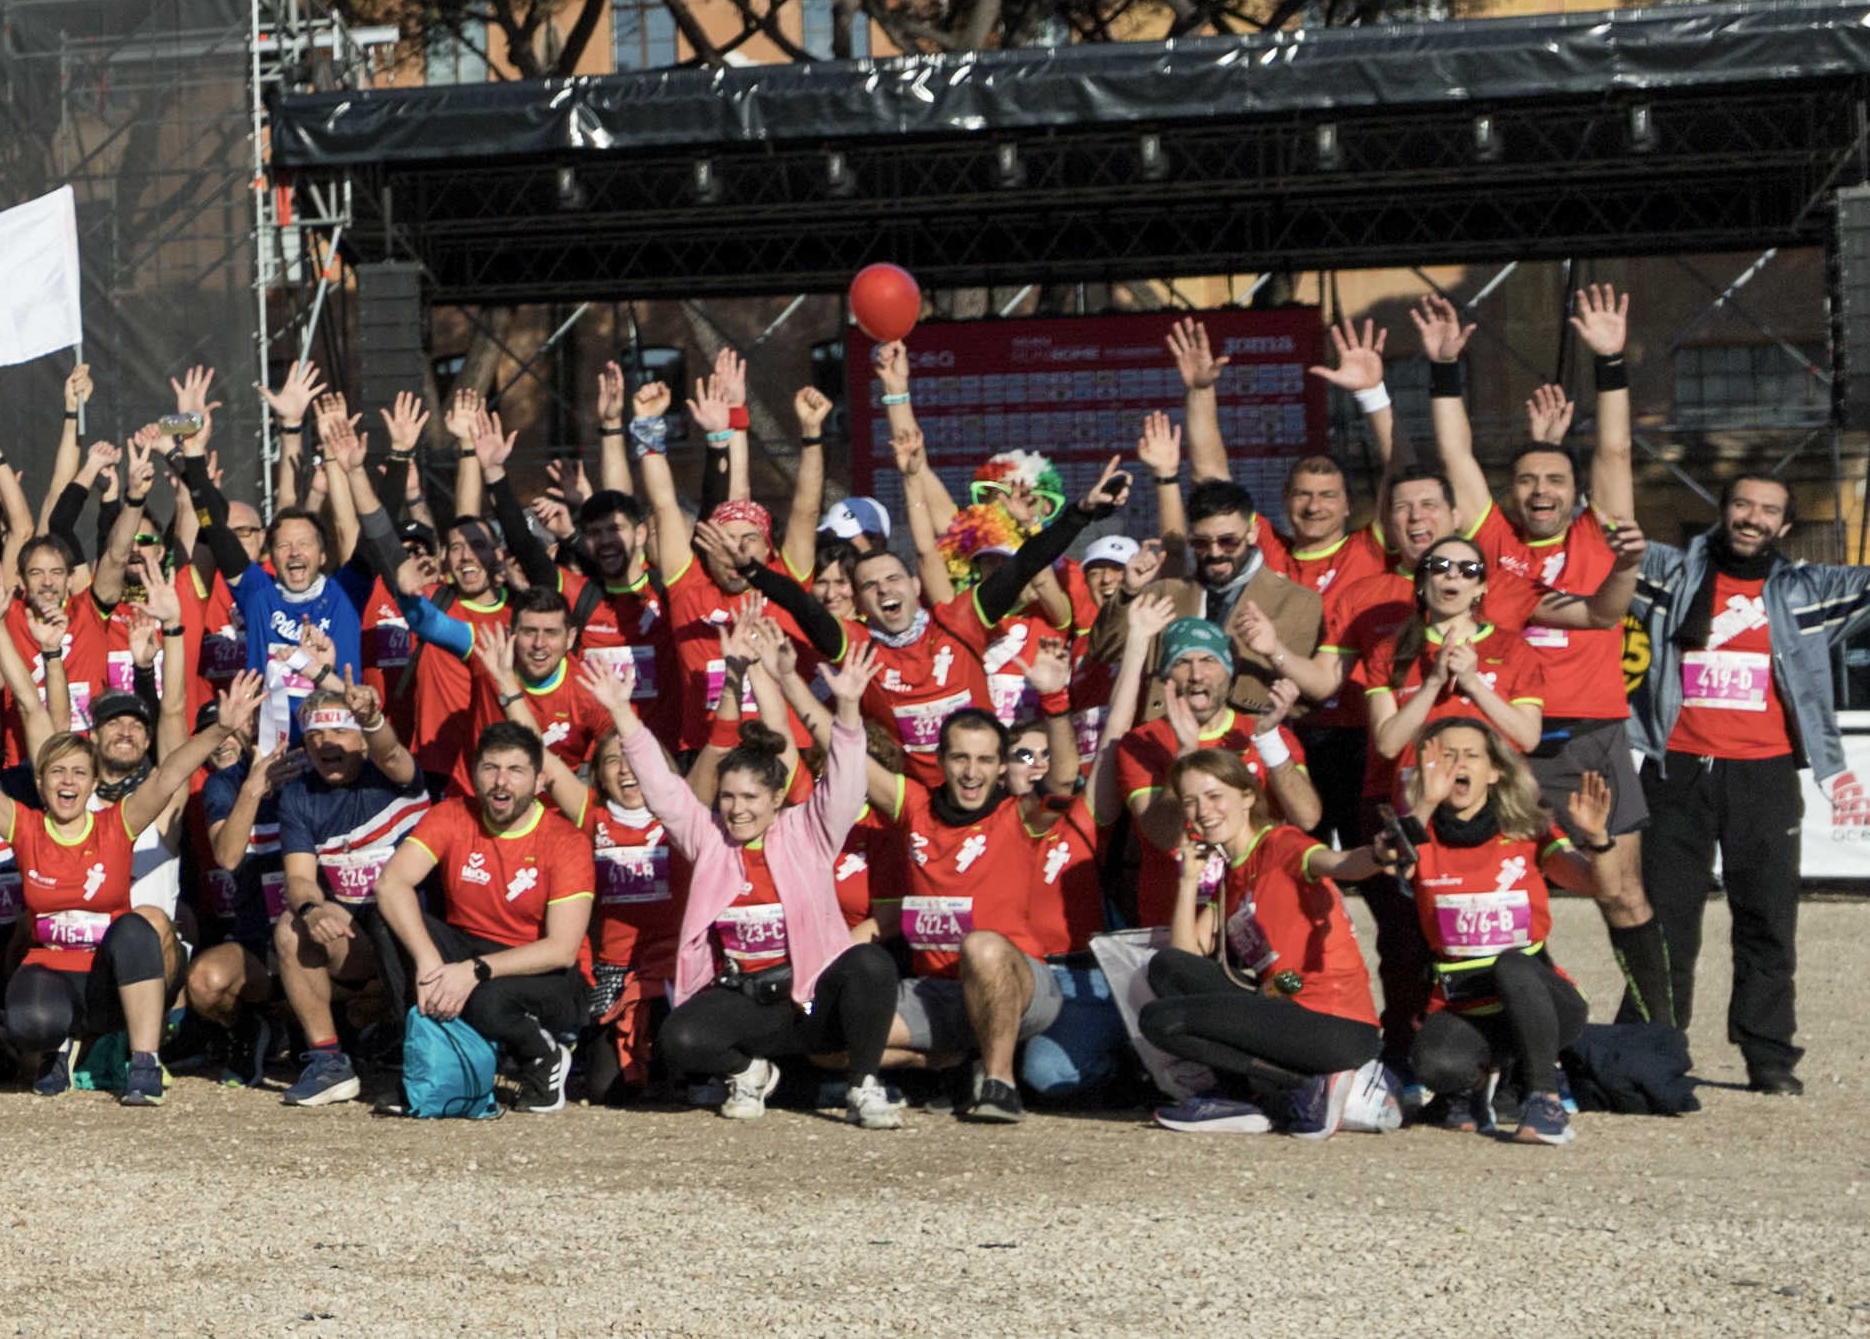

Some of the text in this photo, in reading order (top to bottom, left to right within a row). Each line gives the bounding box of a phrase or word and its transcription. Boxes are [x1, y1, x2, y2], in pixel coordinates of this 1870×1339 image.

[1697, 668, 1753, 691] 419-D
[338, 868, 380, 888] 326-
[49, 922, 94, 944] 715-A
[914, 914, 962, 936] 622-A
[1455, 911, 1514, 934] 676-B
